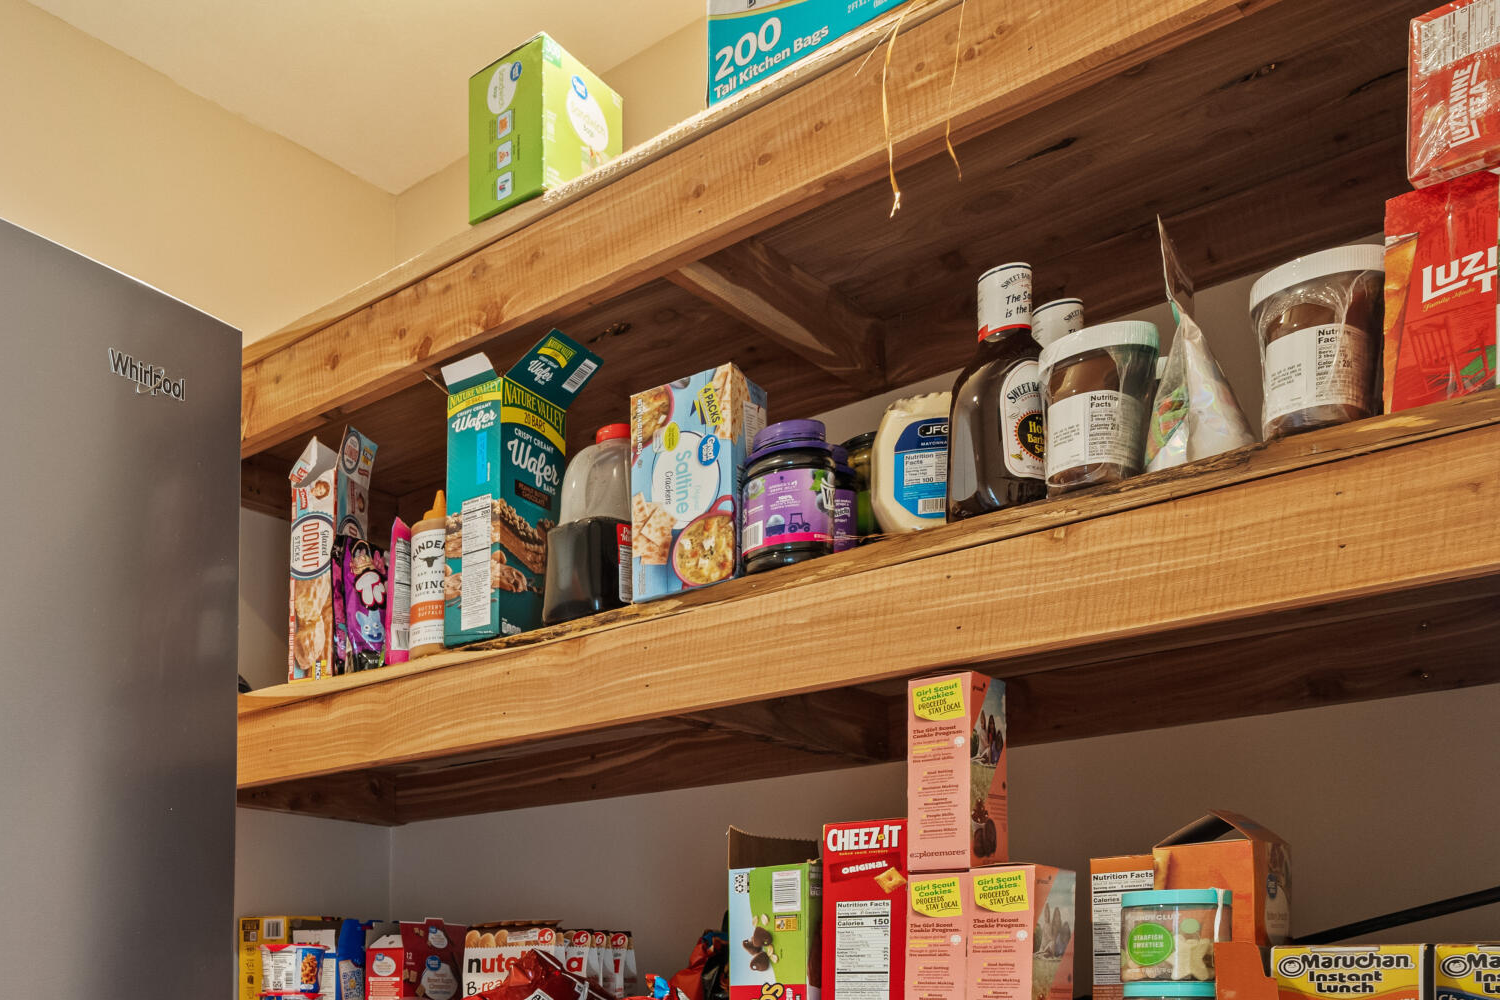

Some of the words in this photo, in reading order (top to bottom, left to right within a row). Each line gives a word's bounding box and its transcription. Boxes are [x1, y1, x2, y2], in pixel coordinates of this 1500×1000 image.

[715, 17, 781, 81] 200
[714, 75, 736, 98] Tall
[739, 47, 790, 85] Kitchen
[794, 25, 829, 52] Bags
[1450, 60, 1481, 148] LUZIANNE
[1001, 273, 1020, 289] SWEET
[1006, 294, 1020, 304] The
[1005, 309, 1012, 318] is
[1017, 305, 1027, 315] the
[108, 347, 186, 401] Whirlpool
[450, 388, 475, 408] NATURE
[1007, 382, 1030, 403] SWEET
[505, 382, 537, 413] NATURE
[536, 402, 565, 434] VALLEY
[705, 394, 721, 424] PACKS
[452, 410, 497, 432] Wafer
[532, 414, 546, 433] BARS
[514, 428, 533, 443] CRISPY
[534, 438, 554, 454] CREAMY
[508, 439, 560, 488] Wafer
[664, 471, 673, 505] Crackers
[675, 450, 692, 514] Saltine
[543, 484, 556, 495] BARS
[302, 522, 320, 569] DONUT
[320, 529, 330, 556] Glazed
[916, 687, 931, 696] Girl
[934, 683, 957, 692] Scout
[921, 690, 954, 702] Cookies
[918, 699, 946, 710] PROCEEDS
[928, 707, 941, 715] STAY
[944, 702, 961, 712] LOCAL
[910, 849, 966, 859] exploremores
[842, 860, 888, 875] ORIGINAL
[978, 878, 994, 886] Girl
[996, 875, 1021, 883] Scout
[1093, 873, 1128, 881] Nutrition
[915, 884, 930, 892] Girl
[932, 881, 955, 889] Scout
[919, 888, 952, 897] Cookies
[982, 883, 1017, 892] Cookies
[916, 896, 944, 904] PROCEEDS
[980, 890, 1009, 900] PROCEEDS
[1006, 895, 1024, 903] LOCAL
[941, 901, 958, 909] LOCAL
[1308, 971, 1382, 982] Instant
[1317, 982, 1374, 993] Lunch
